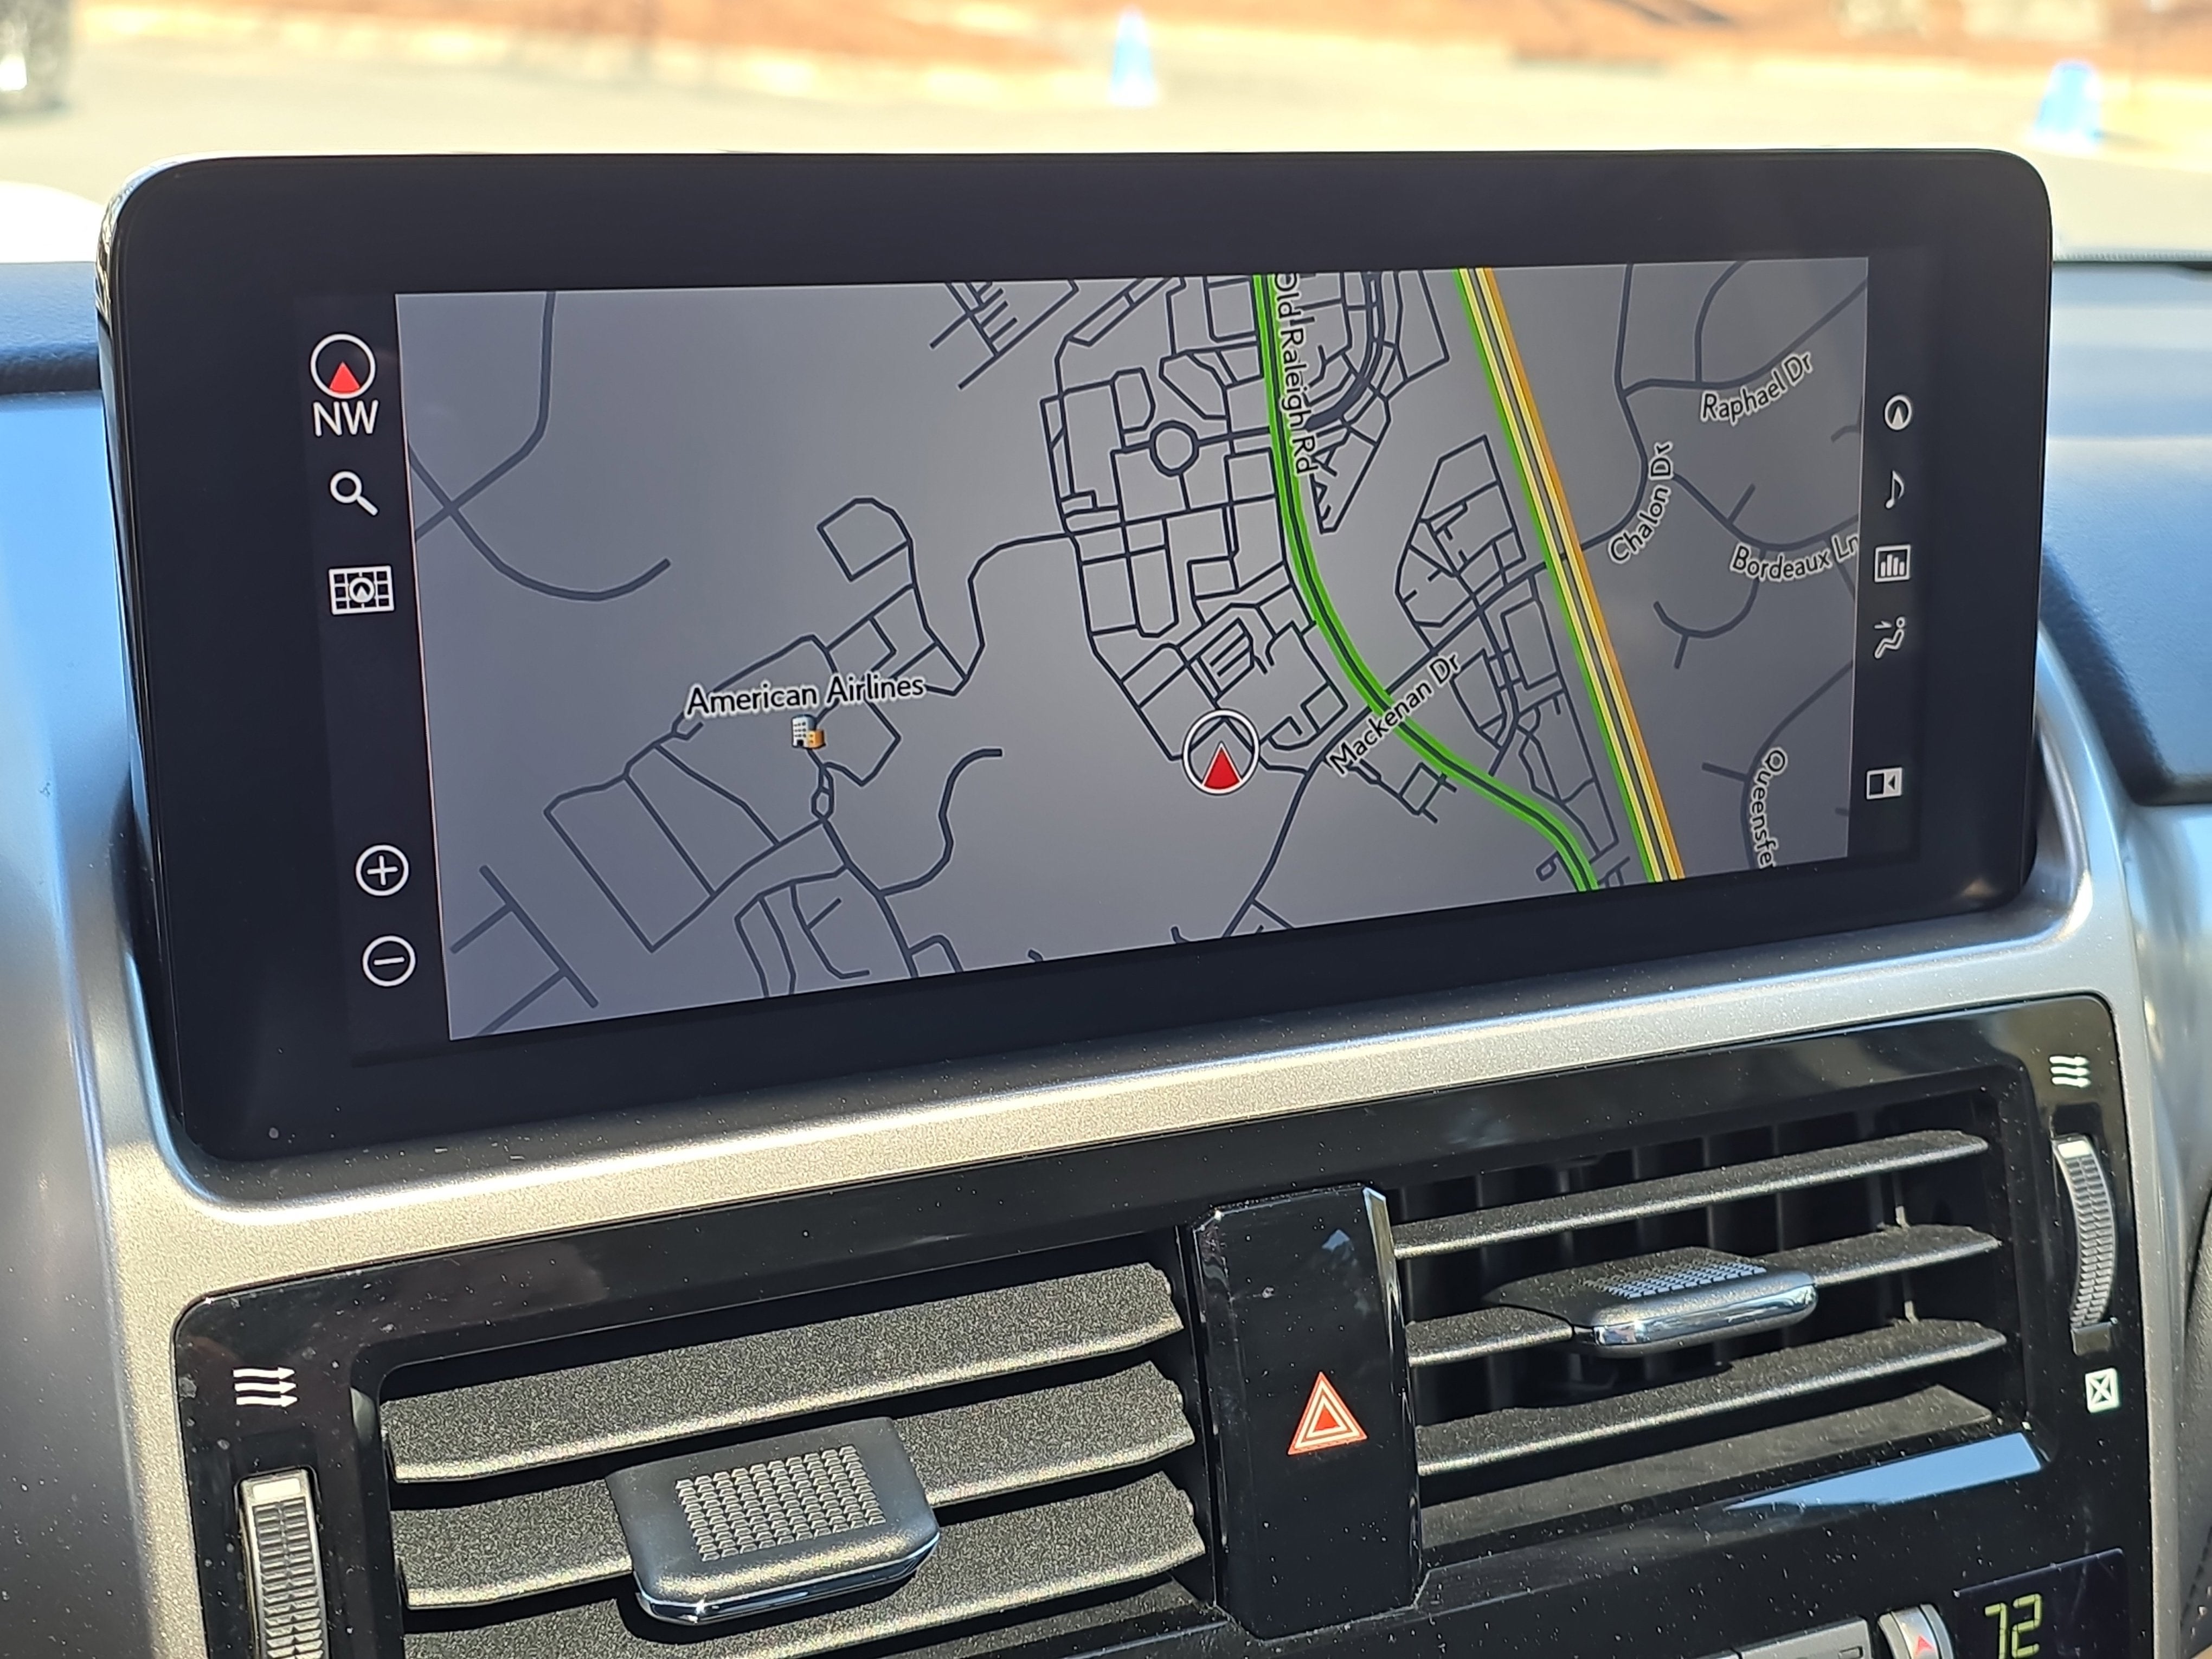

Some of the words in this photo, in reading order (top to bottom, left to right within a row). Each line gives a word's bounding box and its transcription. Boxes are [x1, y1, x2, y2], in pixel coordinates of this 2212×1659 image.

[1274, 273, 1301, 319] Old
[1280, 328, 1310, 426] Raleigh
[1702, 371, 1784, 423] Raphael
[1785, 353, 1811, 383] Dr
[313, 400, 378, 437] NW
[1293, 437, 1317, 474] Rd
[1609, 487, 1668, 562] Chalon
[1651, 443, 1671, 478] Dr
[1732, 546, 1829, 579] Bordeaux
[1834, 536, 1859, 560] Ln
[687, 684, 817, 715] American
[826, 673, 924, 704] Airlines
[1329, 682, 1432, 774] Mackenan
[1429, 654, 1458, 684] Dr
[1752, 749, 1786, 867] Queensfe
[1984, 1594, 2042, 1659] 72
